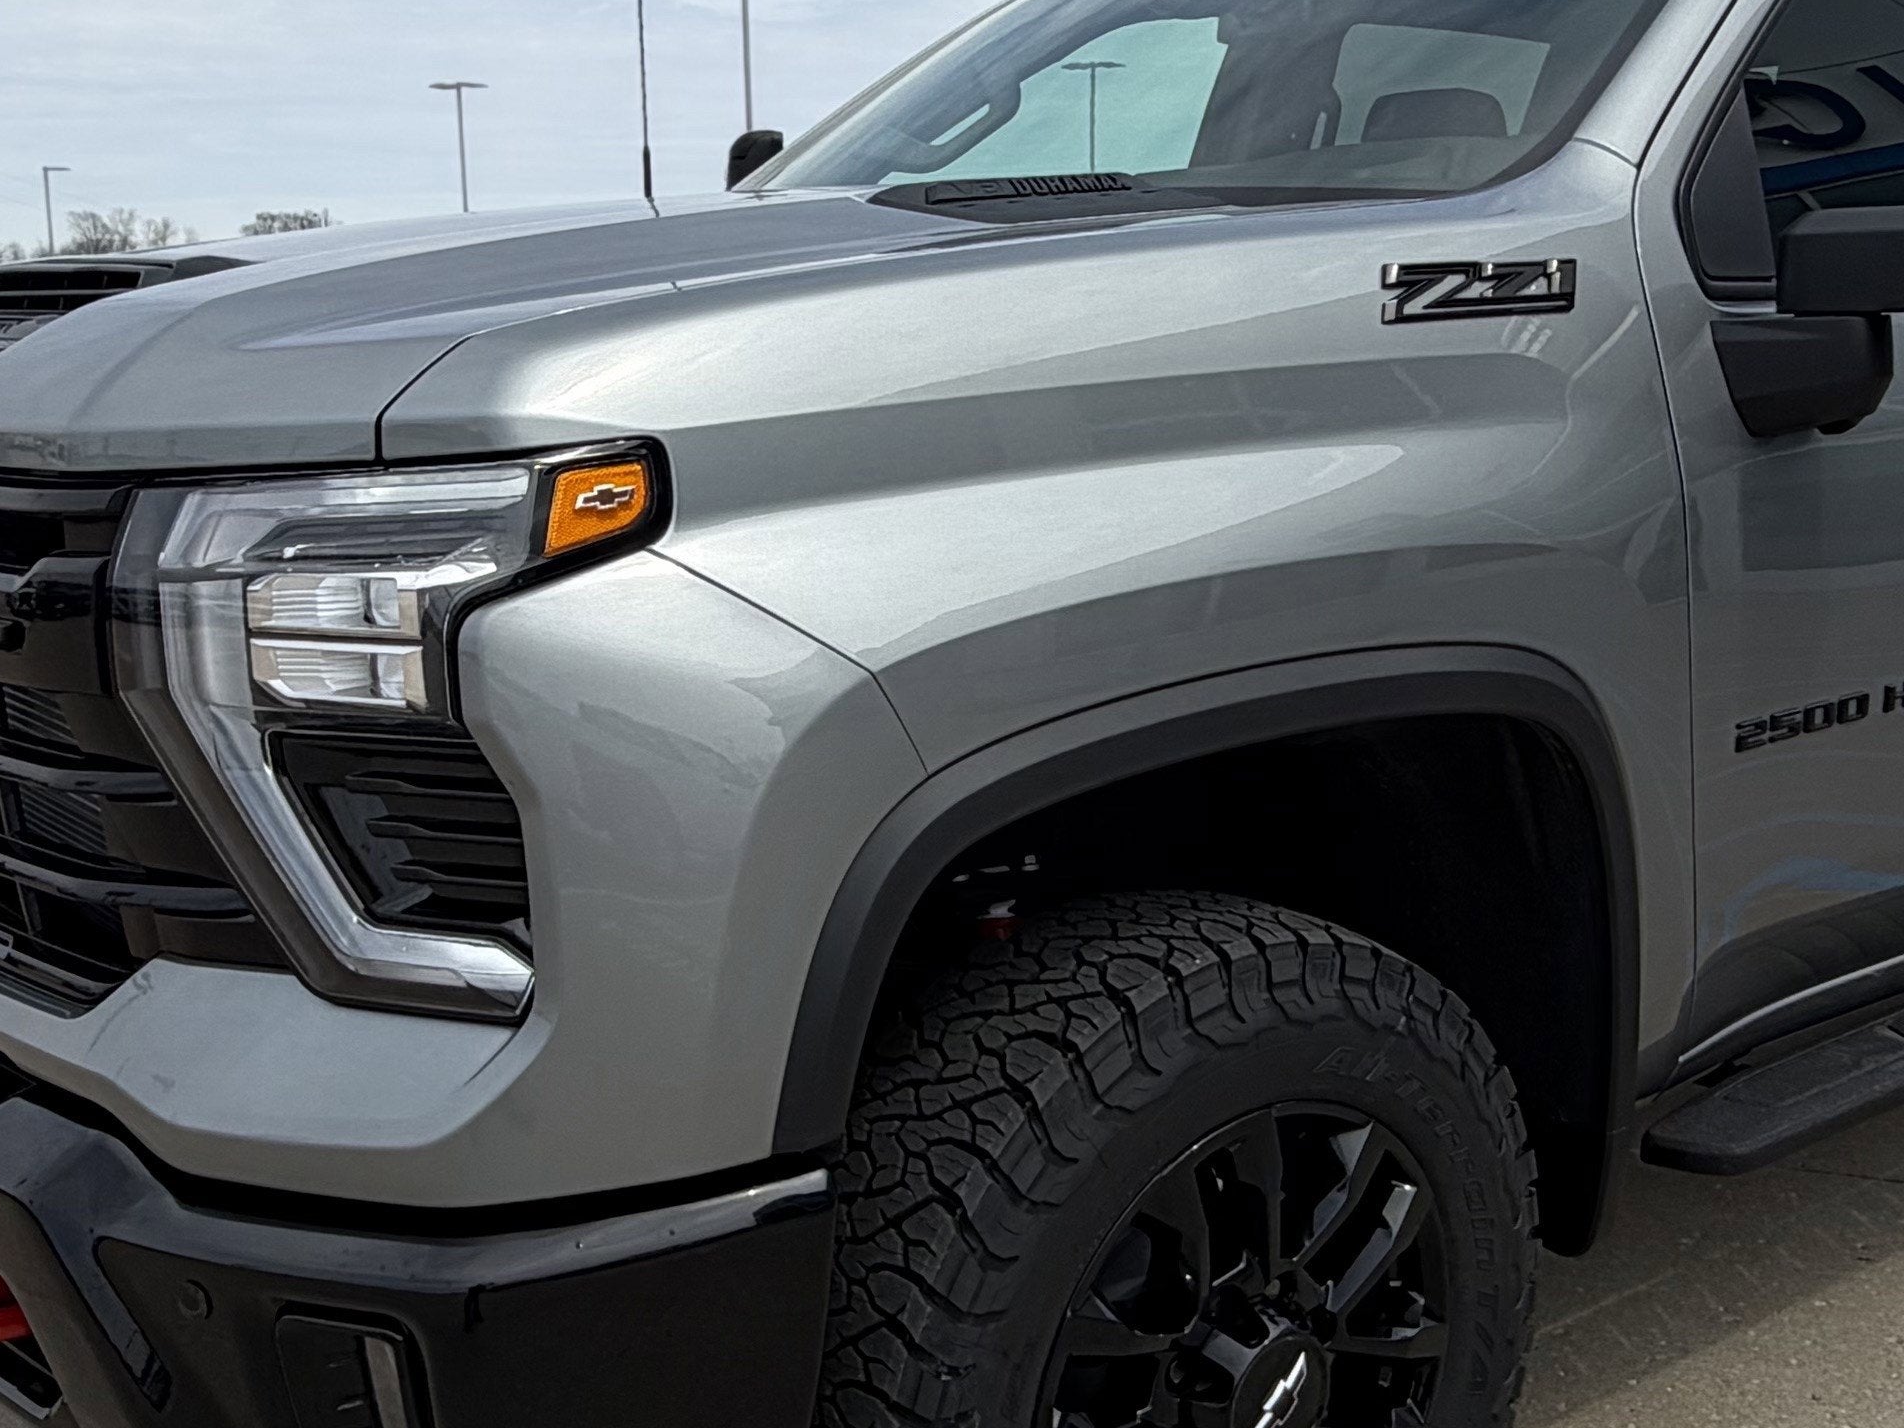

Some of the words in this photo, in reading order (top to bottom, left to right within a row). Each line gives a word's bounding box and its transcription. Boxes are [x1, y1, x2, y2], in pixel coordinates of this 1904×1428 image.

[1008, 174, 1133, 197] DURAMAX
[1381, 258, 1577, 324] Z71
[1734, 691, 1871, 753] 2500
